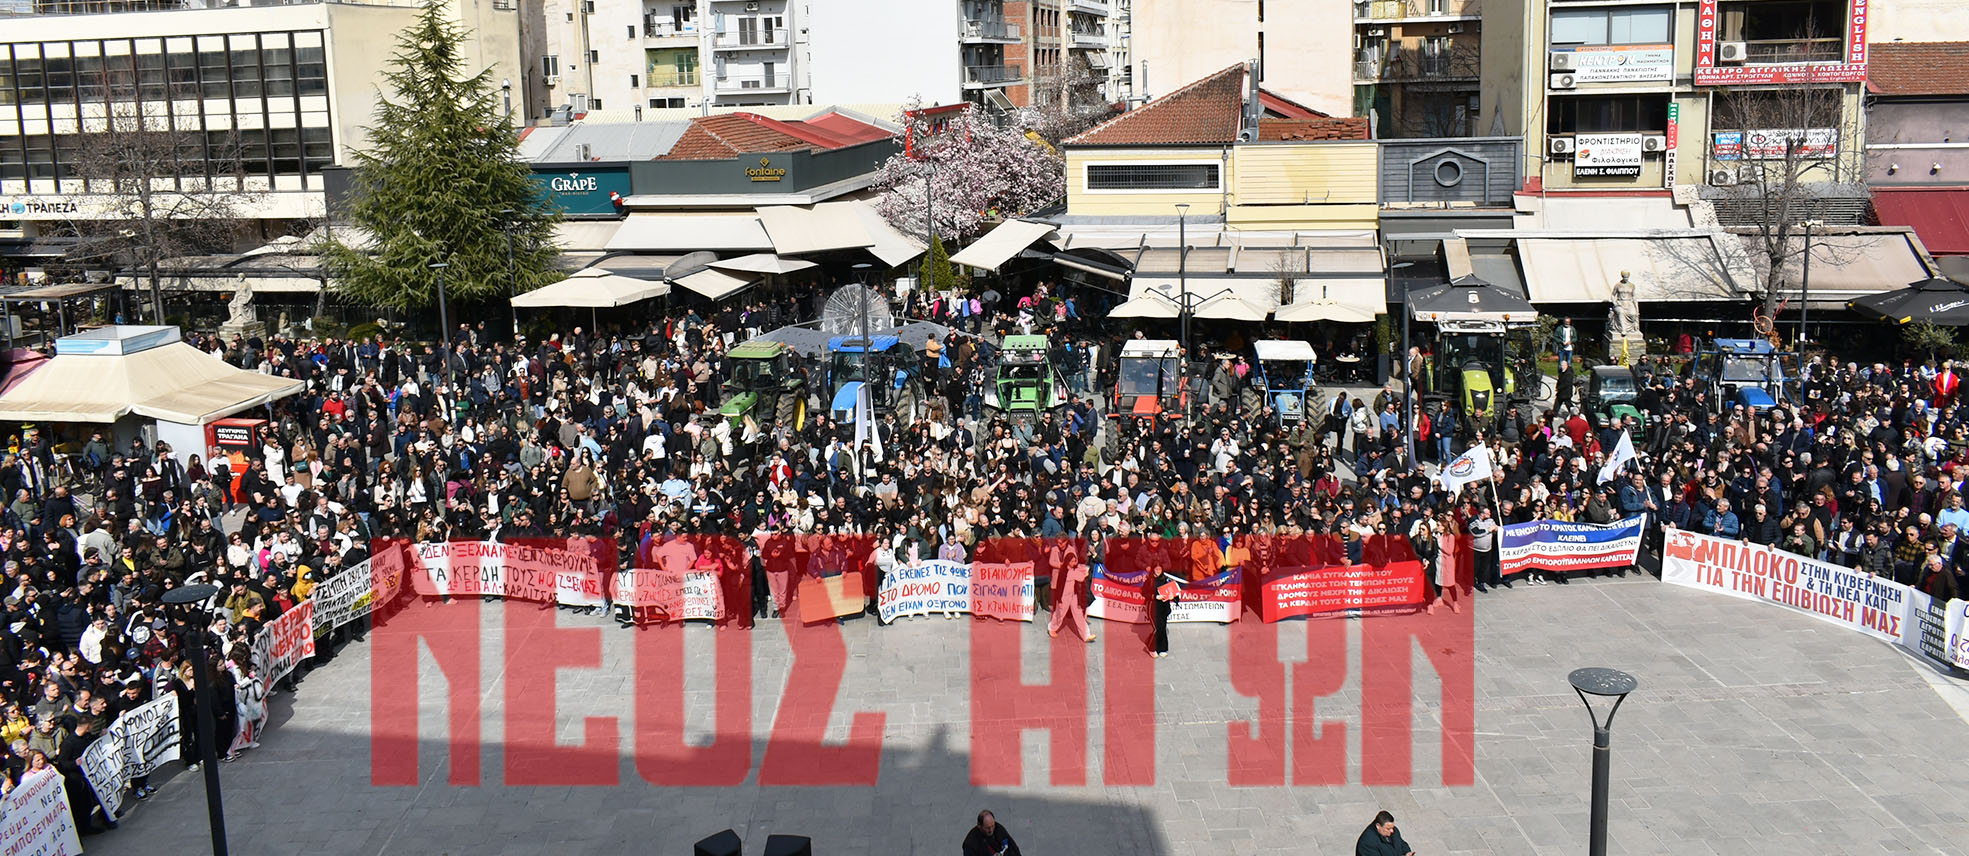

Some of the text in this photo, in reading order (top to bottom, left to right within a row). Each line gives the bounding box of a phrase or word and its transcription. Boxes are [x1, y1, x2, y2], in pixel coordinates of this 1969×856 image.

[1700, 6, 1713, 65] ΑΘΗΝΑ
[1578, 137, 1640, 145] ΦΡΟΝΤΙΣΤΗΡΙΟ
[745, 166, 786, 176] fontaine
[1606, 167, 1639, 175] ΦΙΛΙΠΠΟΥ
[1667, 152, 1675, 187] ΠΑΣΧΟΣ
[551, 177, 598, 191] GRAPE
[26, 202, 78, 213] ΤΡΑΠΕΖΑ
[425, 544, 450, 558] ΔΕΝ
[518, 548, 537, 562] ΔΕΝ
[1700, 538, 1799, 585] ΜΠΛΟΚΟ
[315, 574, 347, 600] ΤΕΜΠΗ
[360, 564, 368, 575] ΤΟ
[420, 567, 446, 582] ΤΑ
[454, 566, 498, 582] ΚΕΡΔΗ
[502, 566, 538, 586] ΤΟΥΣ
[880, 564, 1032, 591] ΓΙΑ ΕΚΕΙΝΕΣ ΤΙΣ ΦΩΝΕΣ ΒΓΑΙΝΟΥΜΕ
[1293, 572, 1322, 580] ΚΑΜΙΑ
[1322, 570, 1374, 579] ΣΥΓΚΑΛΥΨΗ
[1801, 561, 1902, 604] ΣΤΗΝ ΚΥΒΕΡΝΗΣΗ
[464, 580, 499, 594] ΕΠΑΛ
[1094, 584, 1104, 592] ΤΟ
[1104, 586, 1121, 596] ΔΙΚΙΟ
[1122, 590, 1132, 598] ΘΑ
[1214, 589, 1238, 597] ΔΡΟΜΟ
[1271, 582, 1327, 591] ΕΓΚΛΗΜΑΤΟΣ
[1349, 578, 1386, 586] ΤΕΜΠΩΝ
[1277, 586, 1408, 600] ΔΡΟΜΟΥΣ ΜΕΧΡΙ ΤΗΝ ΔΙΚΑΙΩΣΗ
[879, 582, 1033, 606] ΣΤΟ ΔΡΟΜΟ ΠΟΥ ΣΙΓΗΣΑΝ ΓΙΑΤΙ
[1290, 599, 1318, 607] ΚΕΡΔΗ
[1319, 598, 1341, 606] ΤΟΥΣ
[1364, 596, 1387, 604] ΖΩΕΣ
[1697, 564, 1901, 638] ΓΙΑ ΤΗΝ ΕΠΙΒΙΩΣΗ ΜΑΣ
[1806, 579, 1888, 612] & ΤΗ ΝΕΑ ΚΑΠ
[679, 607, 704, 618] ΖΩΕΣ
[882, 604, 896, 620] ΔΕΝ
[898, 600, 923, 612] ΕΙΧΑΝ
[927, 599, 967, 609] ΟΞΥΓΟΝΟ
[40, 782, 62, 808] Νερό
[4, 801, 68, 856] ΕΜΠΟΡΕΥΜΑΤΑ
